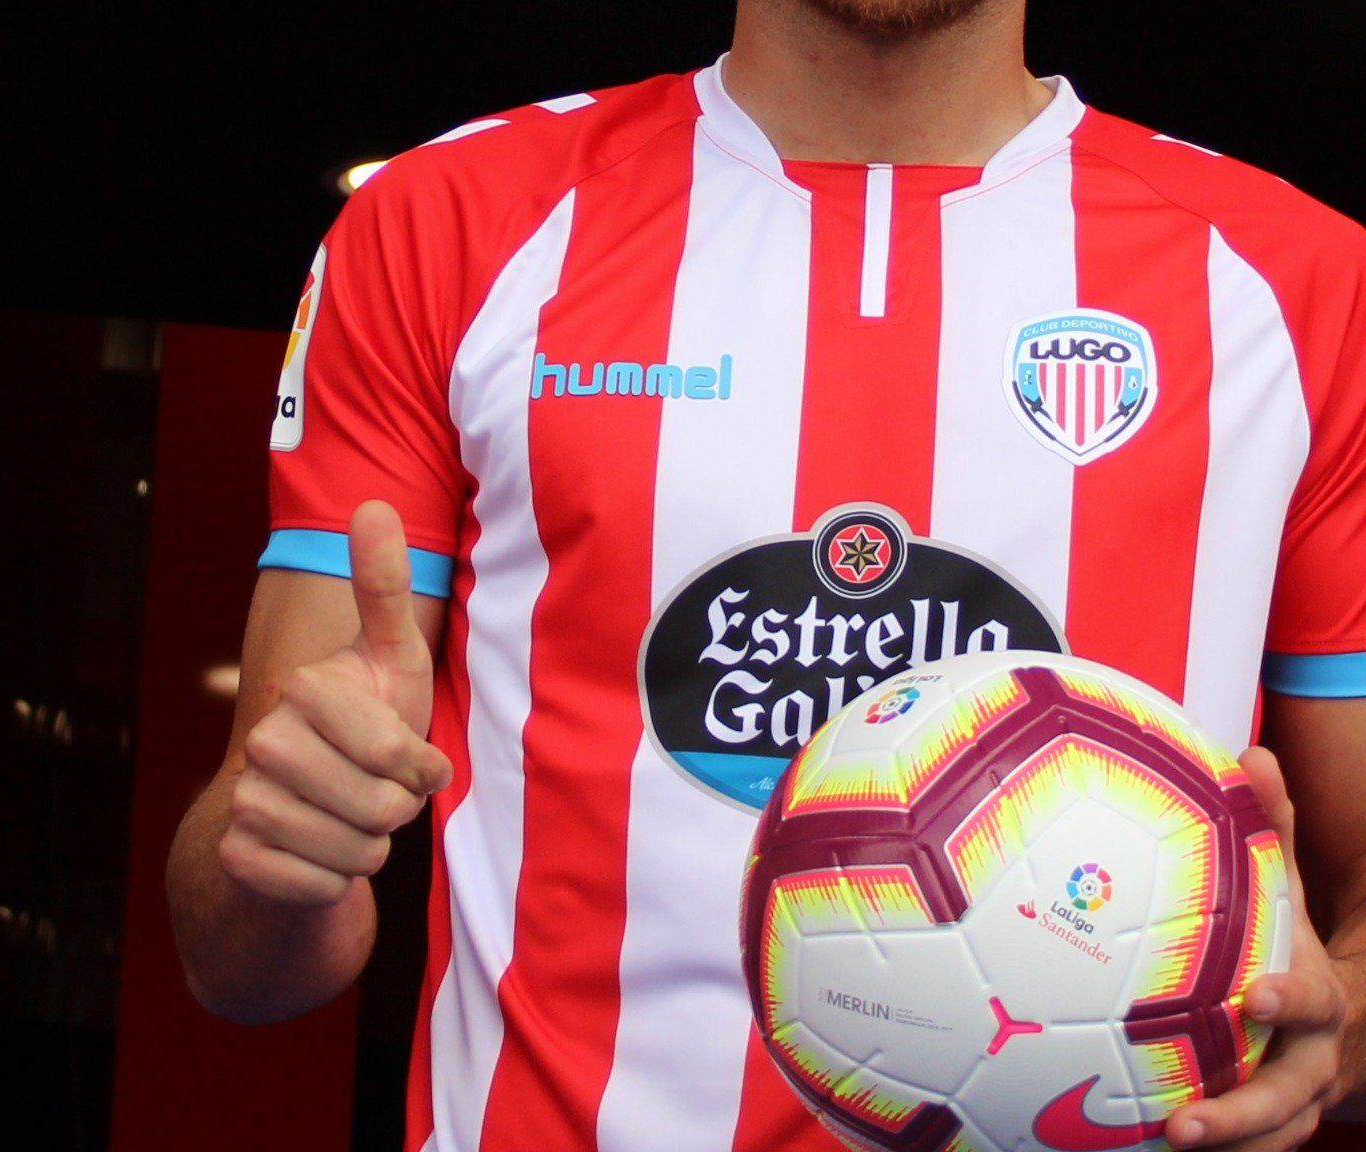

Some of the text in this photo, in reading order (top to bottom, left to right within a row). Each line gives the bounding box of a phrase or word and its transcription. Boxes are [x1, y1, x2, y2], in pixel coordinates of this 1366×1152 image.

[1023, 319, 1139, 343] CLUB DEPORTIVO
[1029, 338, 1132, 363] LUGO
[531, 353, 732, 401] hummel
[698, 587, 1009, 670] Estrella
[1050, 900, 1095, 934] LaLiga
[1038, 913, 1113, 964] Santander
[827, 989, 890, 1020] MERLIN
